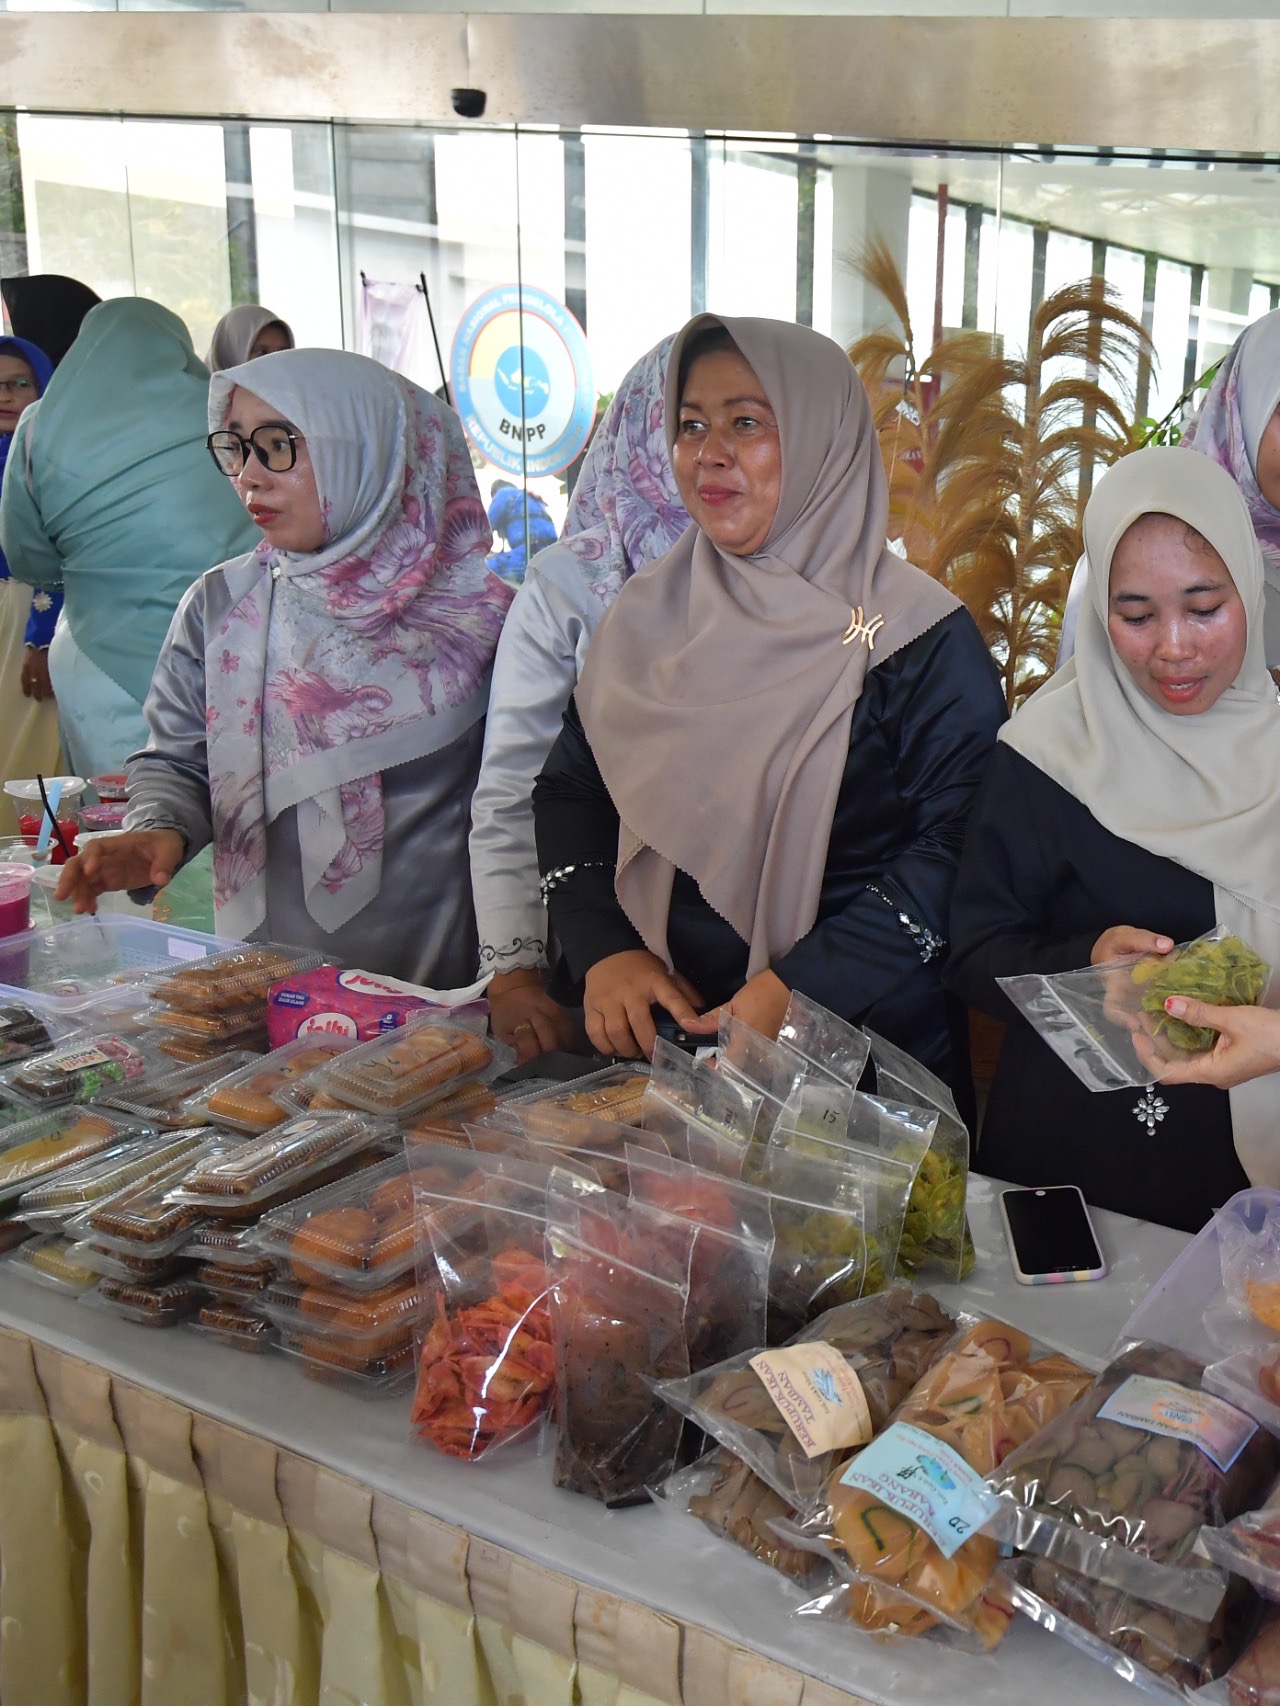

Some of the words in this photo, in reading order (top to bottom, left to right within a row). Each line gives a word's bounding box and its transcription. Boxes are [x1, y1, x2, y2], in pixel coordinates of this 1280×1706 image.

[466, 415, 521, 471] REPUBLIK
[499, 418, 546, 443] BNPP
[823, 1109, 841, 1124] 15
[756, 1359, 776, 1393] IKAN
[777, 1370, 816, 1425] TAMBAN
[775, 1392, 816, 1449] KERUPUK
[849, 1472, 885, 1494] IKAN
